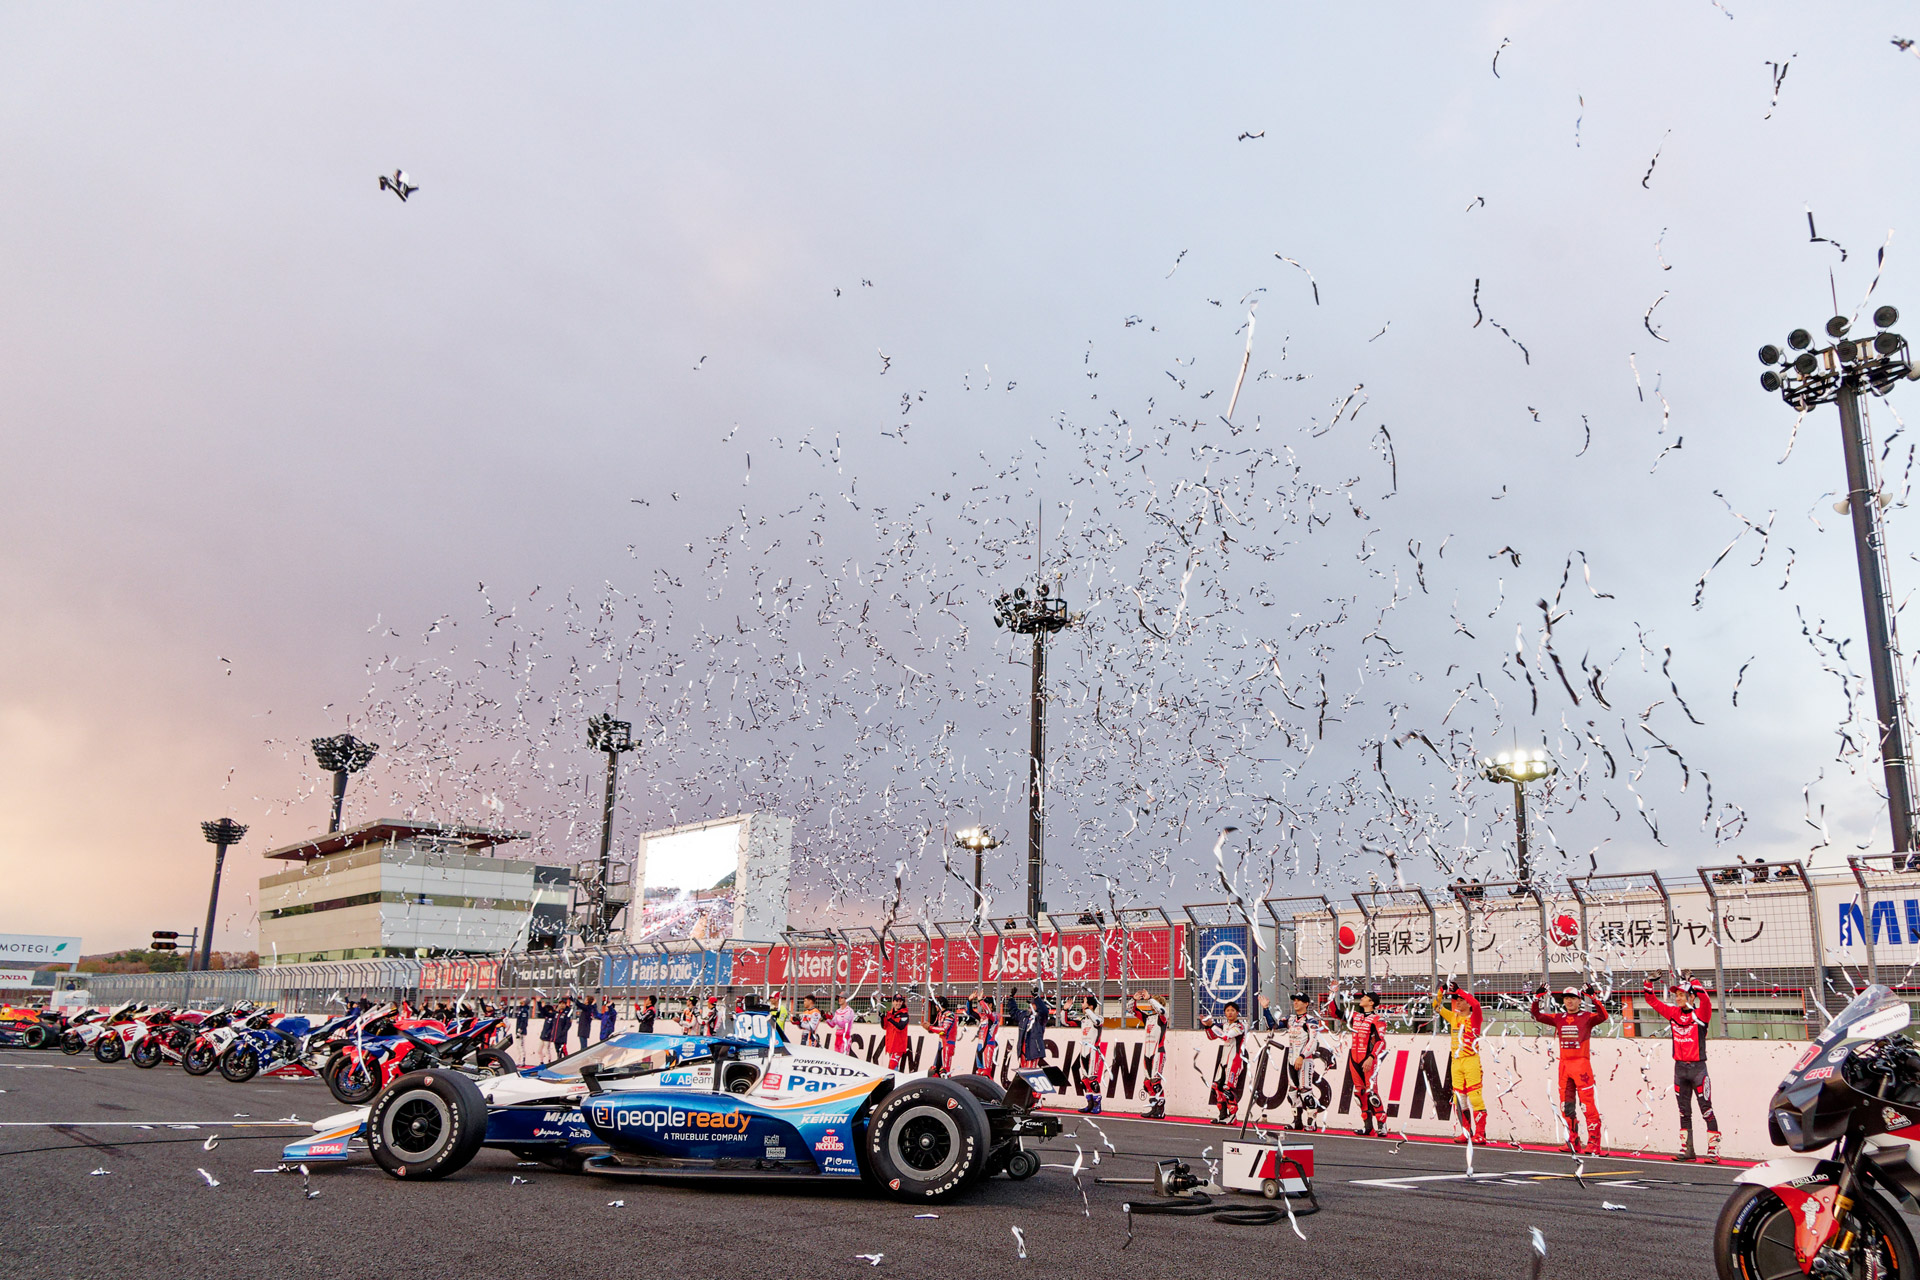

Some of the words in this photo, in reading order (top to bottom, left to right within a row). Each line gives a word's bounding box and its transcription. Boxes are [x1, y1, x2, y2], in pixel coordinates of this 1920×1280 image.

[0, 943, 49, 953] MOTEGI
[782, 949, 848, 978] Astemo
[988, 942, 1087, 977] Astemo
[631, 960, 692, 981] Panasonic
[738, 1014, 768, 1039] 30
[792, 1065, 870, 1078] HONDA
[1803, 1066, 1835, 1081] GIVI
[676, 1074, 713, 1086] ABeam
[787, 1075, 846, 1092] Pan
[1029, 1076, 1053, 1092] 30
[801, 1113, 850, 1124] KEIHIN
[872, 1092, 921, 1154] Firestone
[436, 1102, 459, 1163] Firestone
[664, 1133, 669, 1141] A
[671, 1133, 709, 1141] TRUEBLUE
[711, 1134, 748, 1142] COMPANY
[821, 1135, 839, 1143] CUP
[311, 1144, 342, 1153] TOTAL
[925, 1135, 974, 1197] Firestone
